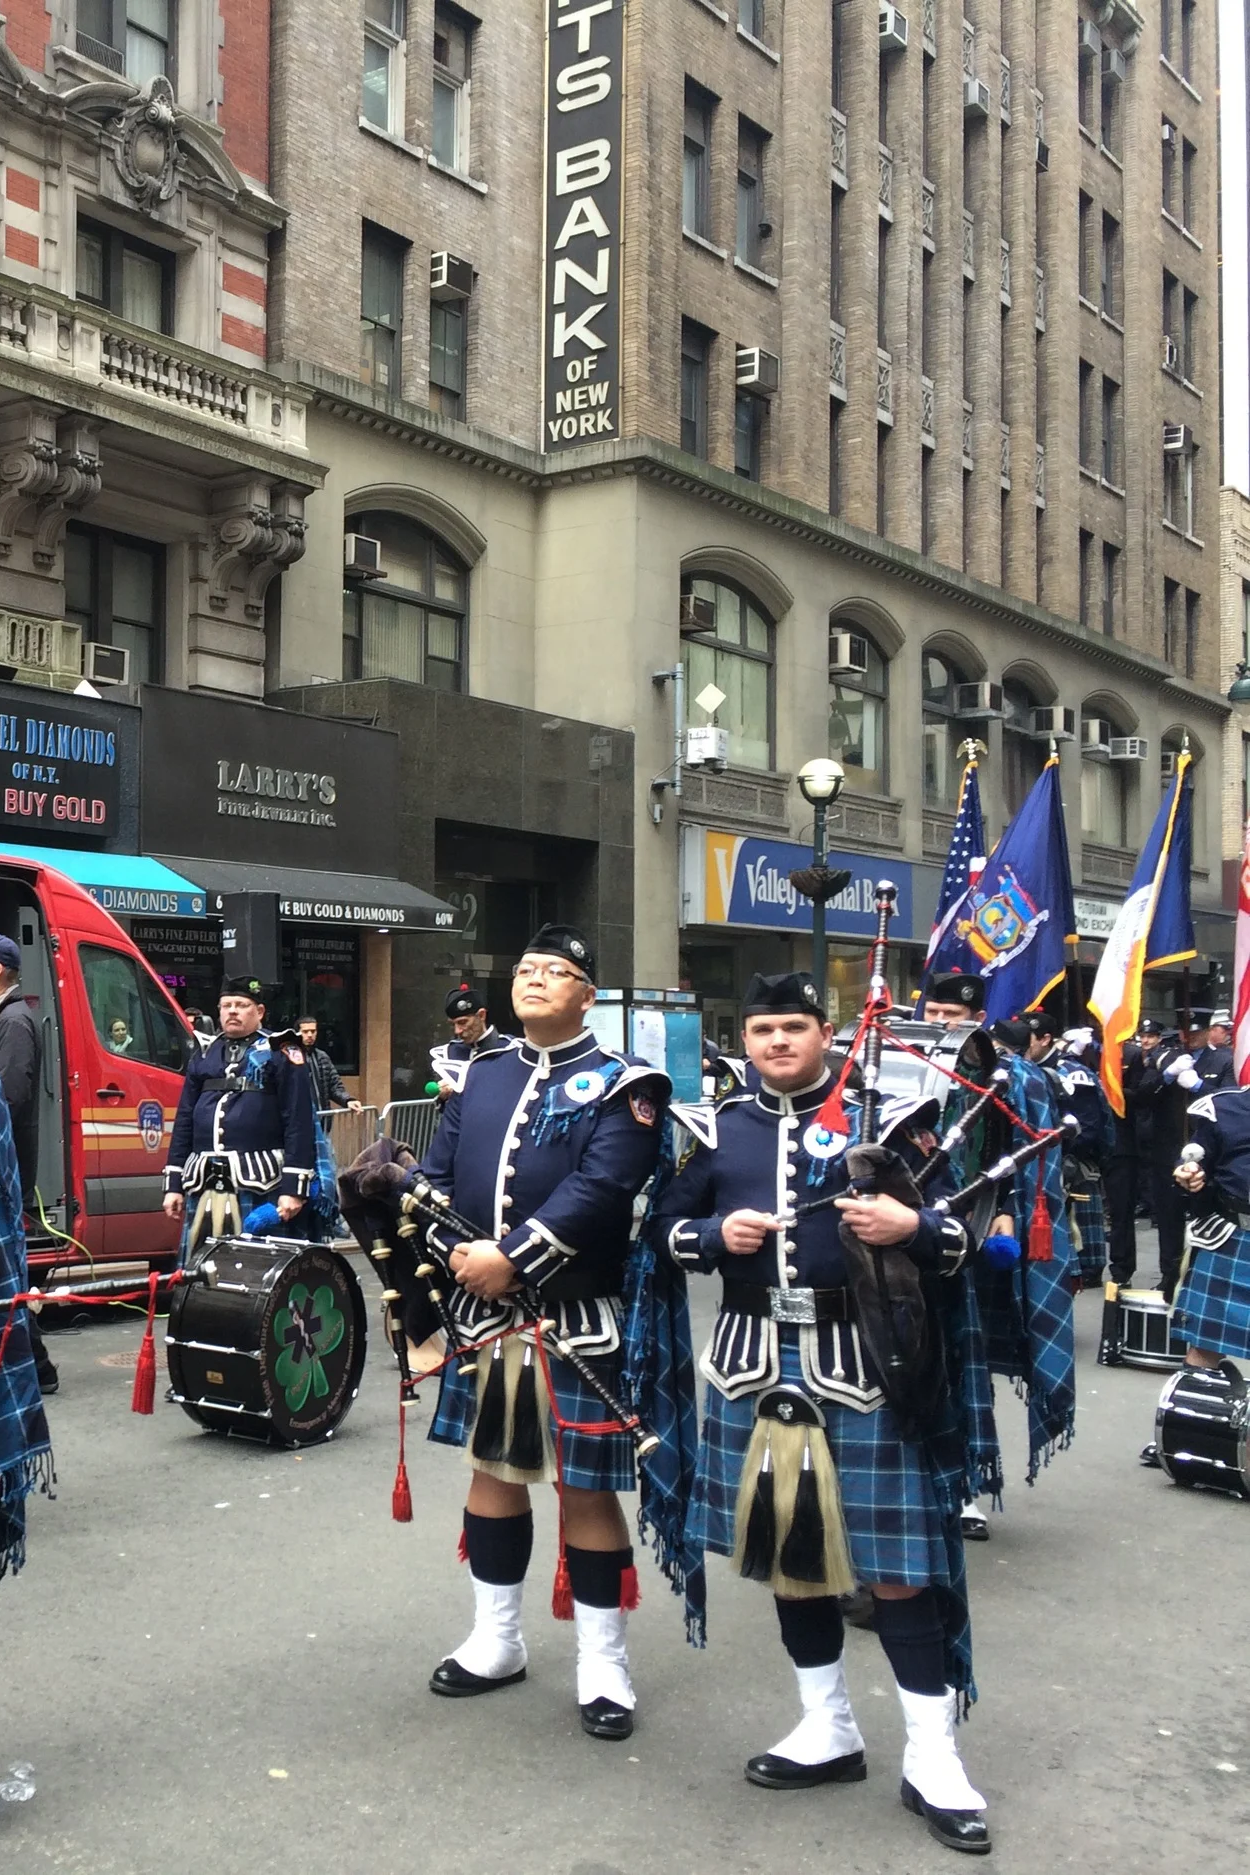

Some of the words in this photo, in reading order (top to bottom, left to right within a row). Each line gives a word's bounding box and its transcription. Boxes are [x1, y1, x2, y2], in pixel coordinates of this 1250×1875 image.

[556, 0, 612, 112] TS
[553, 137, 611, 360] BANK
[567, 355, 597, 382] OF
[556, 381, 609, 414] NEW
[548, 408, 614, 442] YORK
[25, 718, 116, 767] DIAMONDS
[12, 762, 30, 780] OF
[33, 765, 60, 784] N.Y.
[217, 760, 336, 805] LARRY'S
[4, 788, 48, 817] BUY
[53, 795, 106, 825] GOLD
[217, 797, 251, 817] FINE
[252, 801, 309, 824] JEWELRY
[103, 889, 178, 913] DIAMONDS
[745, 855, 796, 915] Valley
[293, 902, 312, 917] BUY
[315, 903, 343, 919] GOLD
[345, 905, 352, 919] &
[353, 906, 404, 923] DIAMONDS
[133, 927, 164, 939] LARRY'S
[165, 928, 184, 940] FINE
[185, 930, 217, 942] JEWELRY
[148, 943, 196, 954] ENGAGEMENT
[198, 946, 219, 955] RINGS
